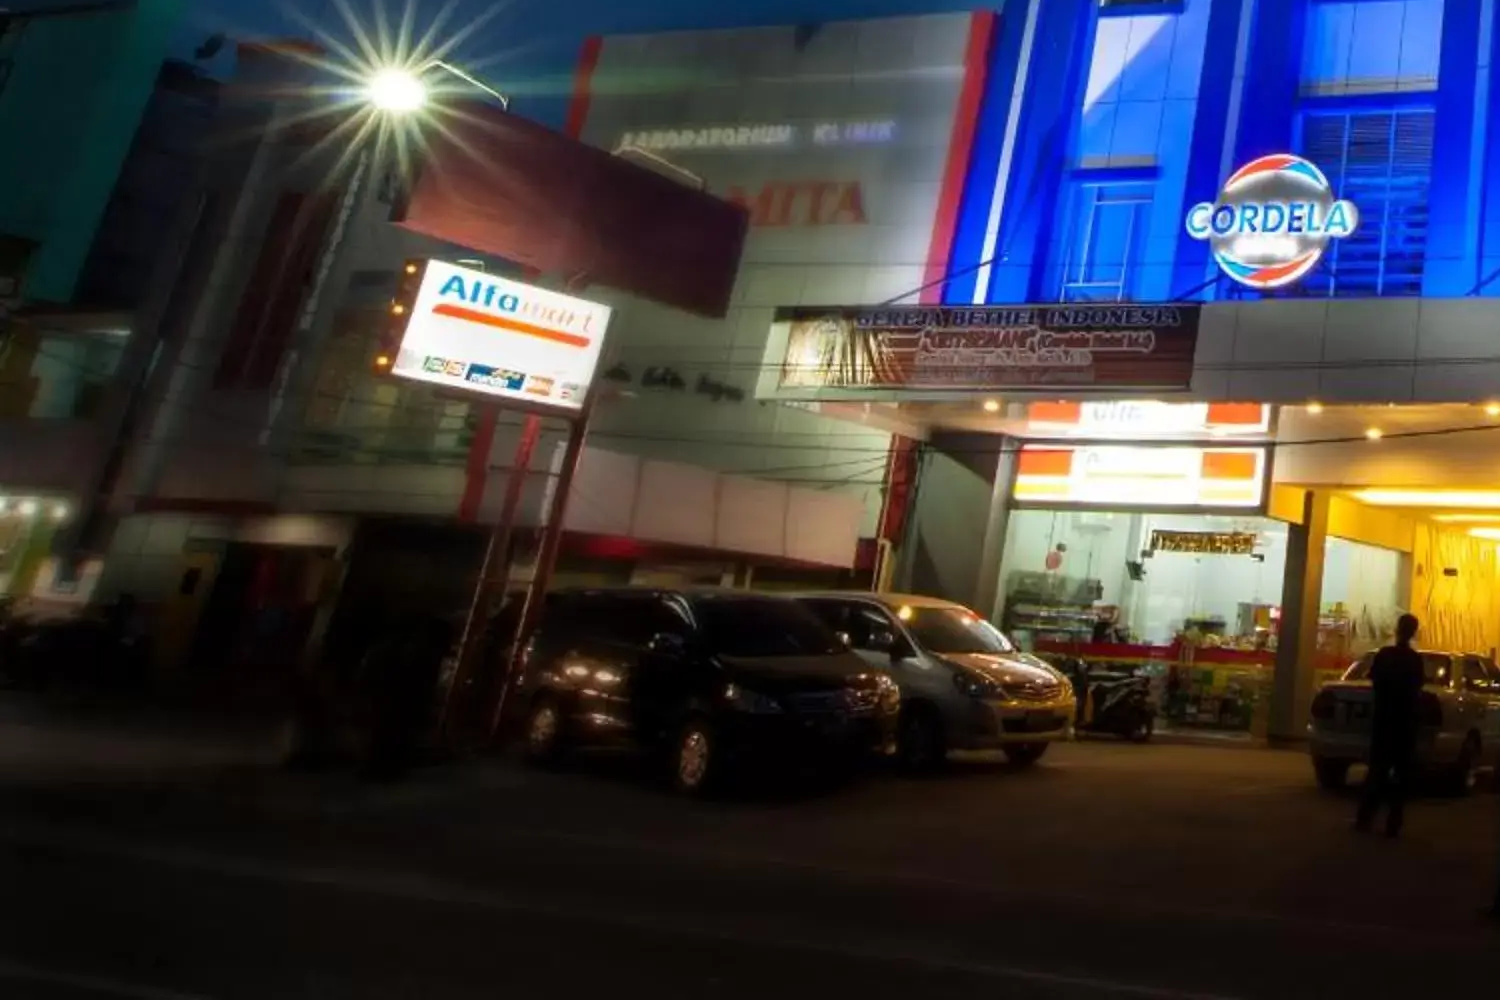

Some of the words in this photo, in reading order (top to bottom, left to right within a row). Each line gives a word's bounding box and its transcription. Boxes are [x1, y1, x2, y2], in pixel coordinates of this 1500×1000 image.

[620, 122, 793, 149] LABORATORIUM
[812, 119, 896, 143] KLINIK
[1186, 201, 1353, 237] CORDELA
[953, 309, 1039, 327] BETHEL
[1047, 307, 1180, 327] INDONESIA
